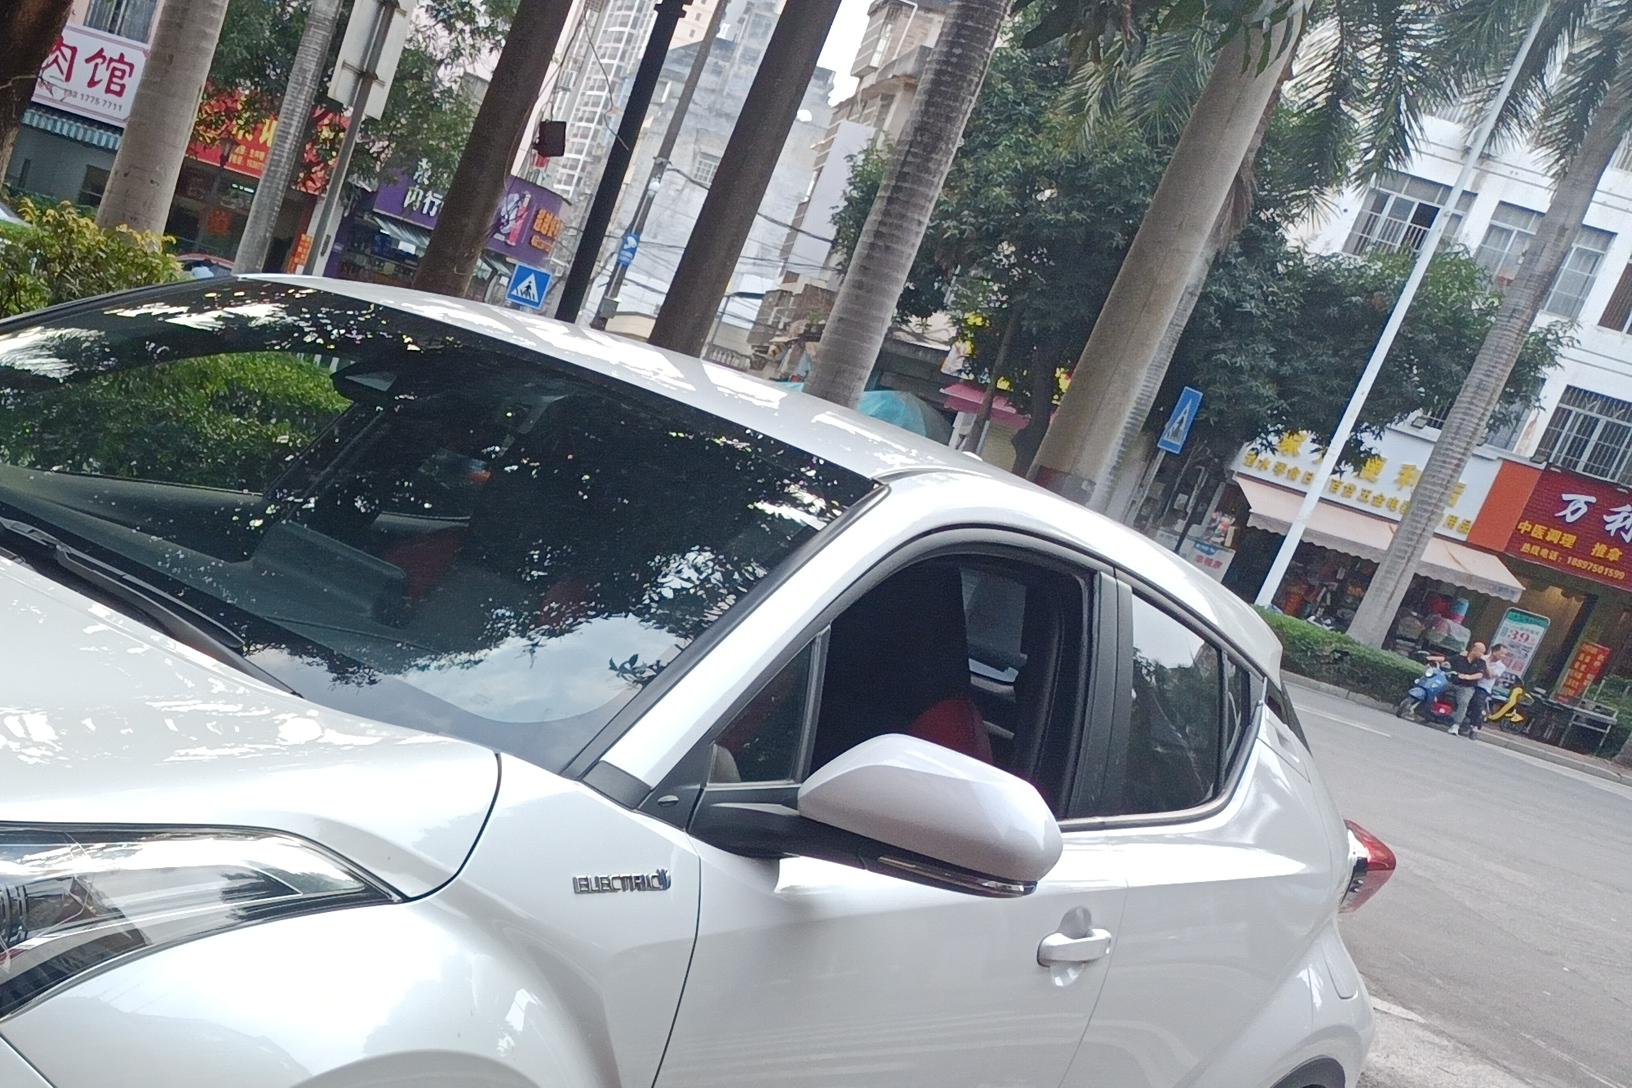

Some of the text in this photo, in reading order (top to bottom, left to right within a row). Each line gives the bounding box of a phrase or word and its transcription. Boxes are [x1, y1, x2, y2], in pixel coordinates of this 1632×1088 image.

[1517, 520, 1623, 562] 中医调理 推拿
